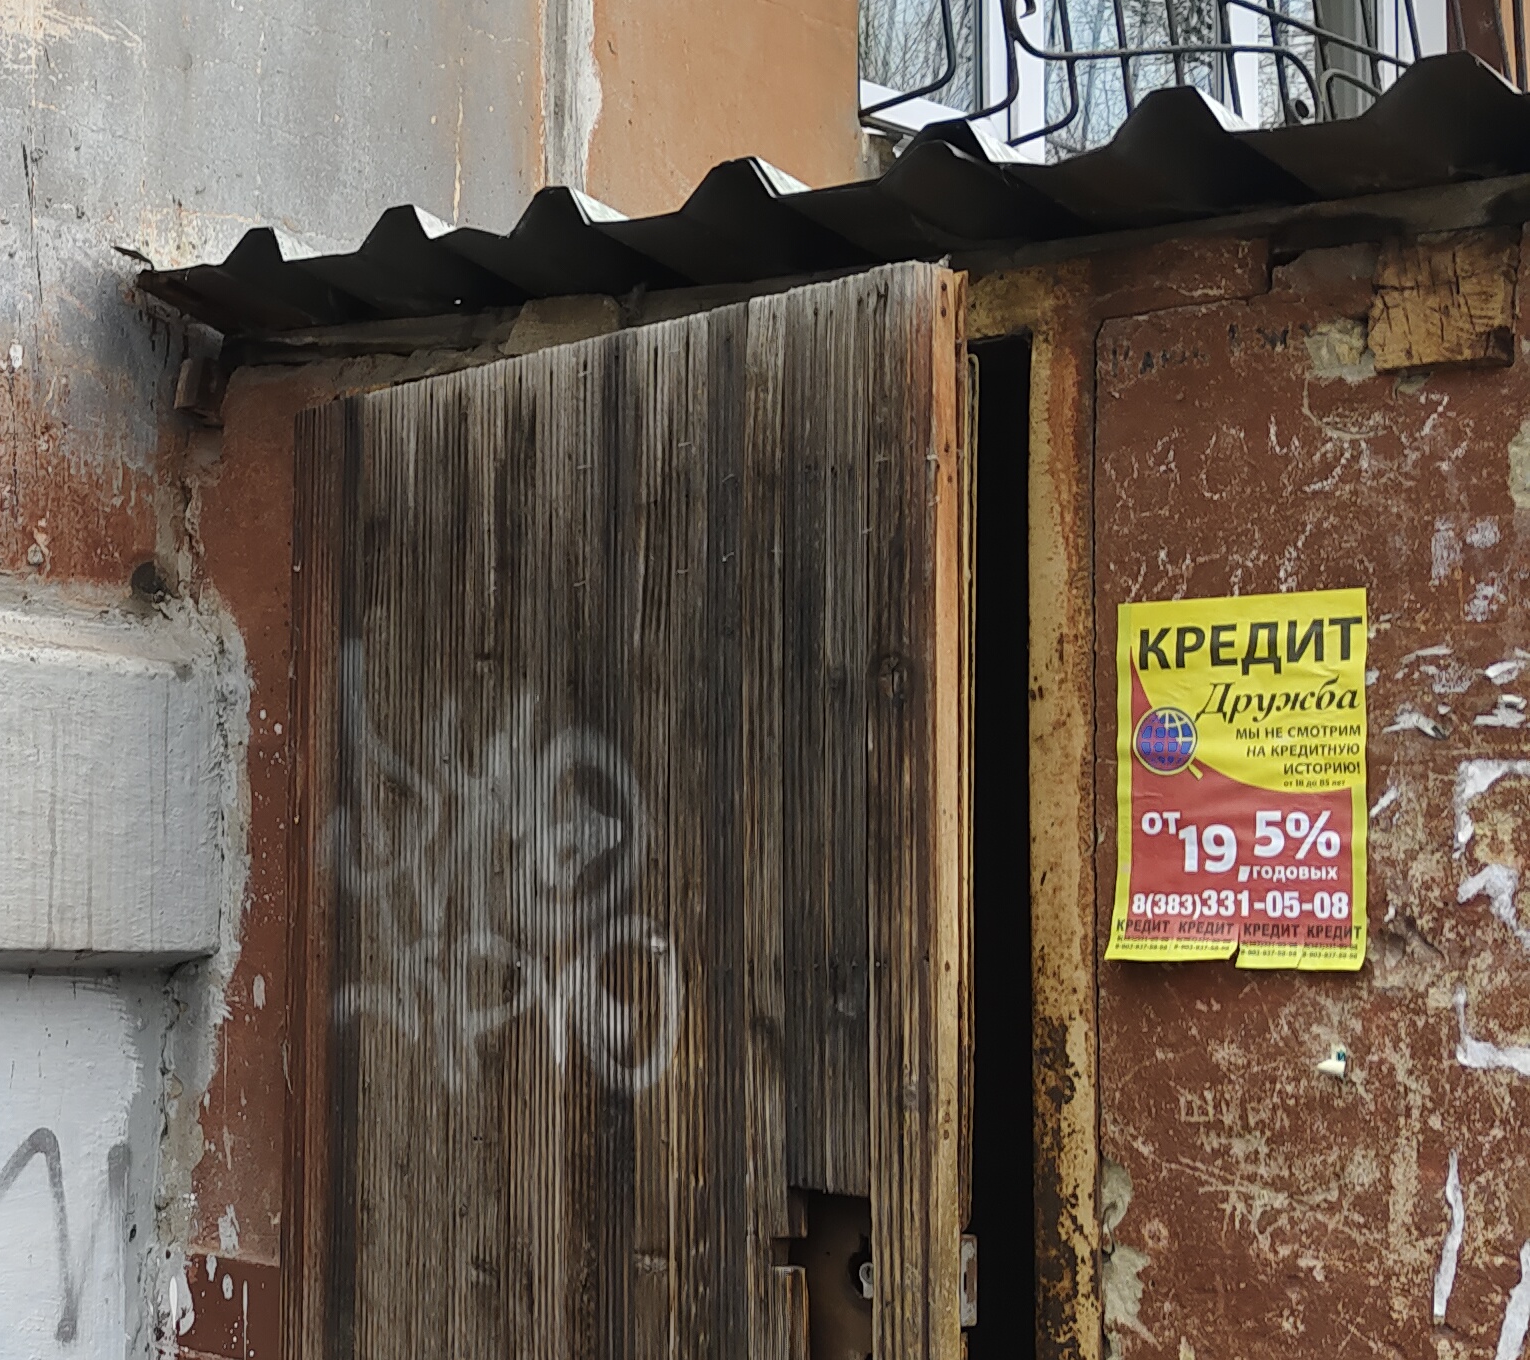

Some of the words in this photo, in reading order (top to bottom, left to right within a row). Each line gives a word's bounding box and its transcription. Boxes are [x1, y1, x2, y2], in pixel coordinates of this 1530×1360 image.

[1139, 616, 1362, 676] КРЕДИТ
[1194, 674, 1360, 724] Дружба
[1235, 727, 1259, 740] МЫ
[1265, 726, 1282, 739] НЕ
[1287, 724, 1361, 738] СМОТРИМ
[1246, 744, 1265, 758] НА
[1270, 742, 1360, 758] КРЕДИТНУЮ
[1283, 761, 1361, 775] ИСТОРИЮ!
[1141, 811, 1181, 835] от
[1253, 866, 1338, 882] годовых
[1132, 889, 1349, 919] 8(383)331-05-08
[1116, 919, 1171, 935] КРЕДИТ
[1178, 920, 1235, 936] КРЕДИТ
[1243, 923, 1299, 939] КРЕДИТ
[1307, 924, 1362, 940] КРЕДИТ
